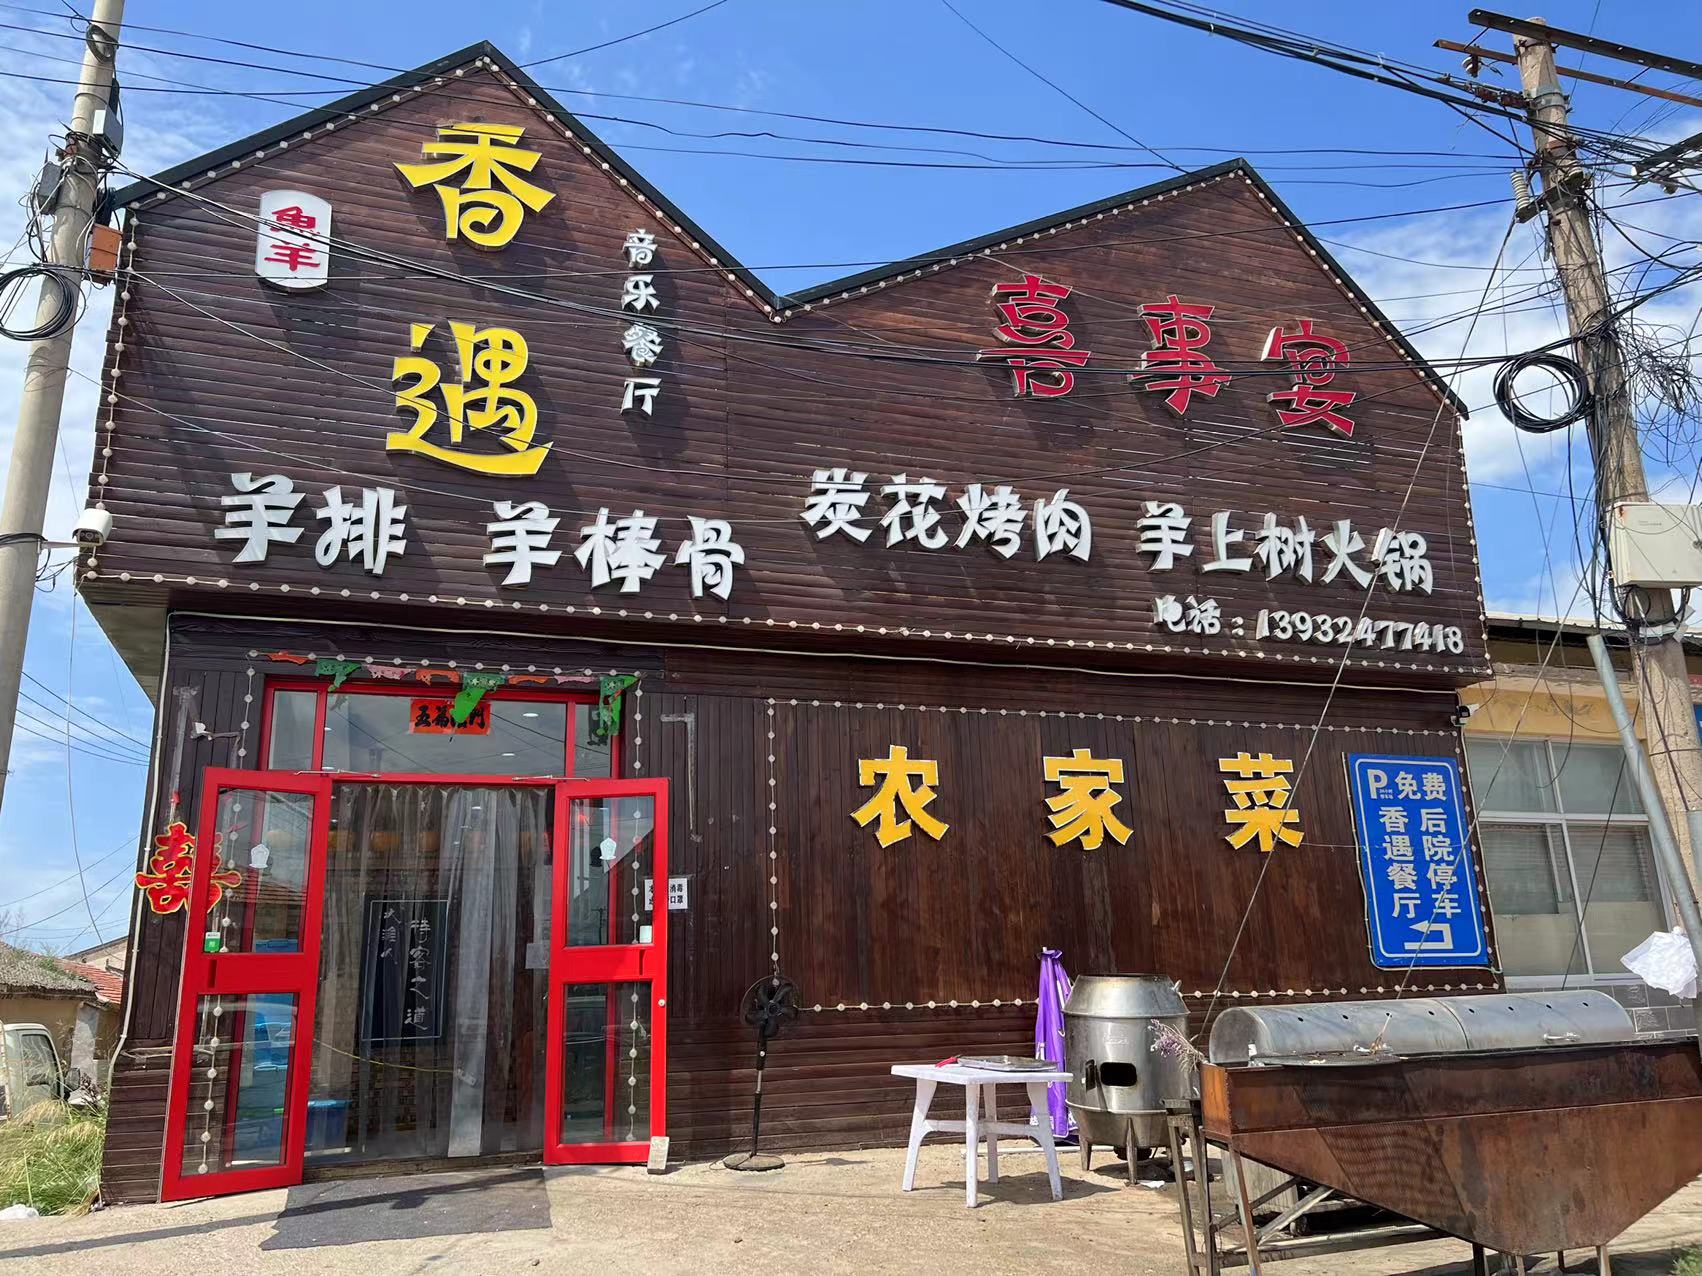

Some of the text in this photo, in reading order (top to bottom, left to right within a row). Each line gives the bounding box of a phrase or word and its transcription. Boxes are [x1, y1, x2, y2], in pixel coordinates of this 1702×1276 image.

[386, 123, 556, 474] 香遇
[620, 228, 664, 416] 音乐餐厅
[976, 274, 1360, 438] 喜事宴
[214, 472, 409, 576] 羊排
[482, 500, 745, 600] 羊棒骨
[800, 467, 1092, 562] 炭花烤肉
[1135, 501, 1433, 596] 羊上树火锅
[850, 744, 1306, 852] 农家菜
[1394, 771, 1447, 801] 免费
[1379, 807, 1421, 919] 香遇餐厅
[1420, 808, 1462, 919] 后院停车
